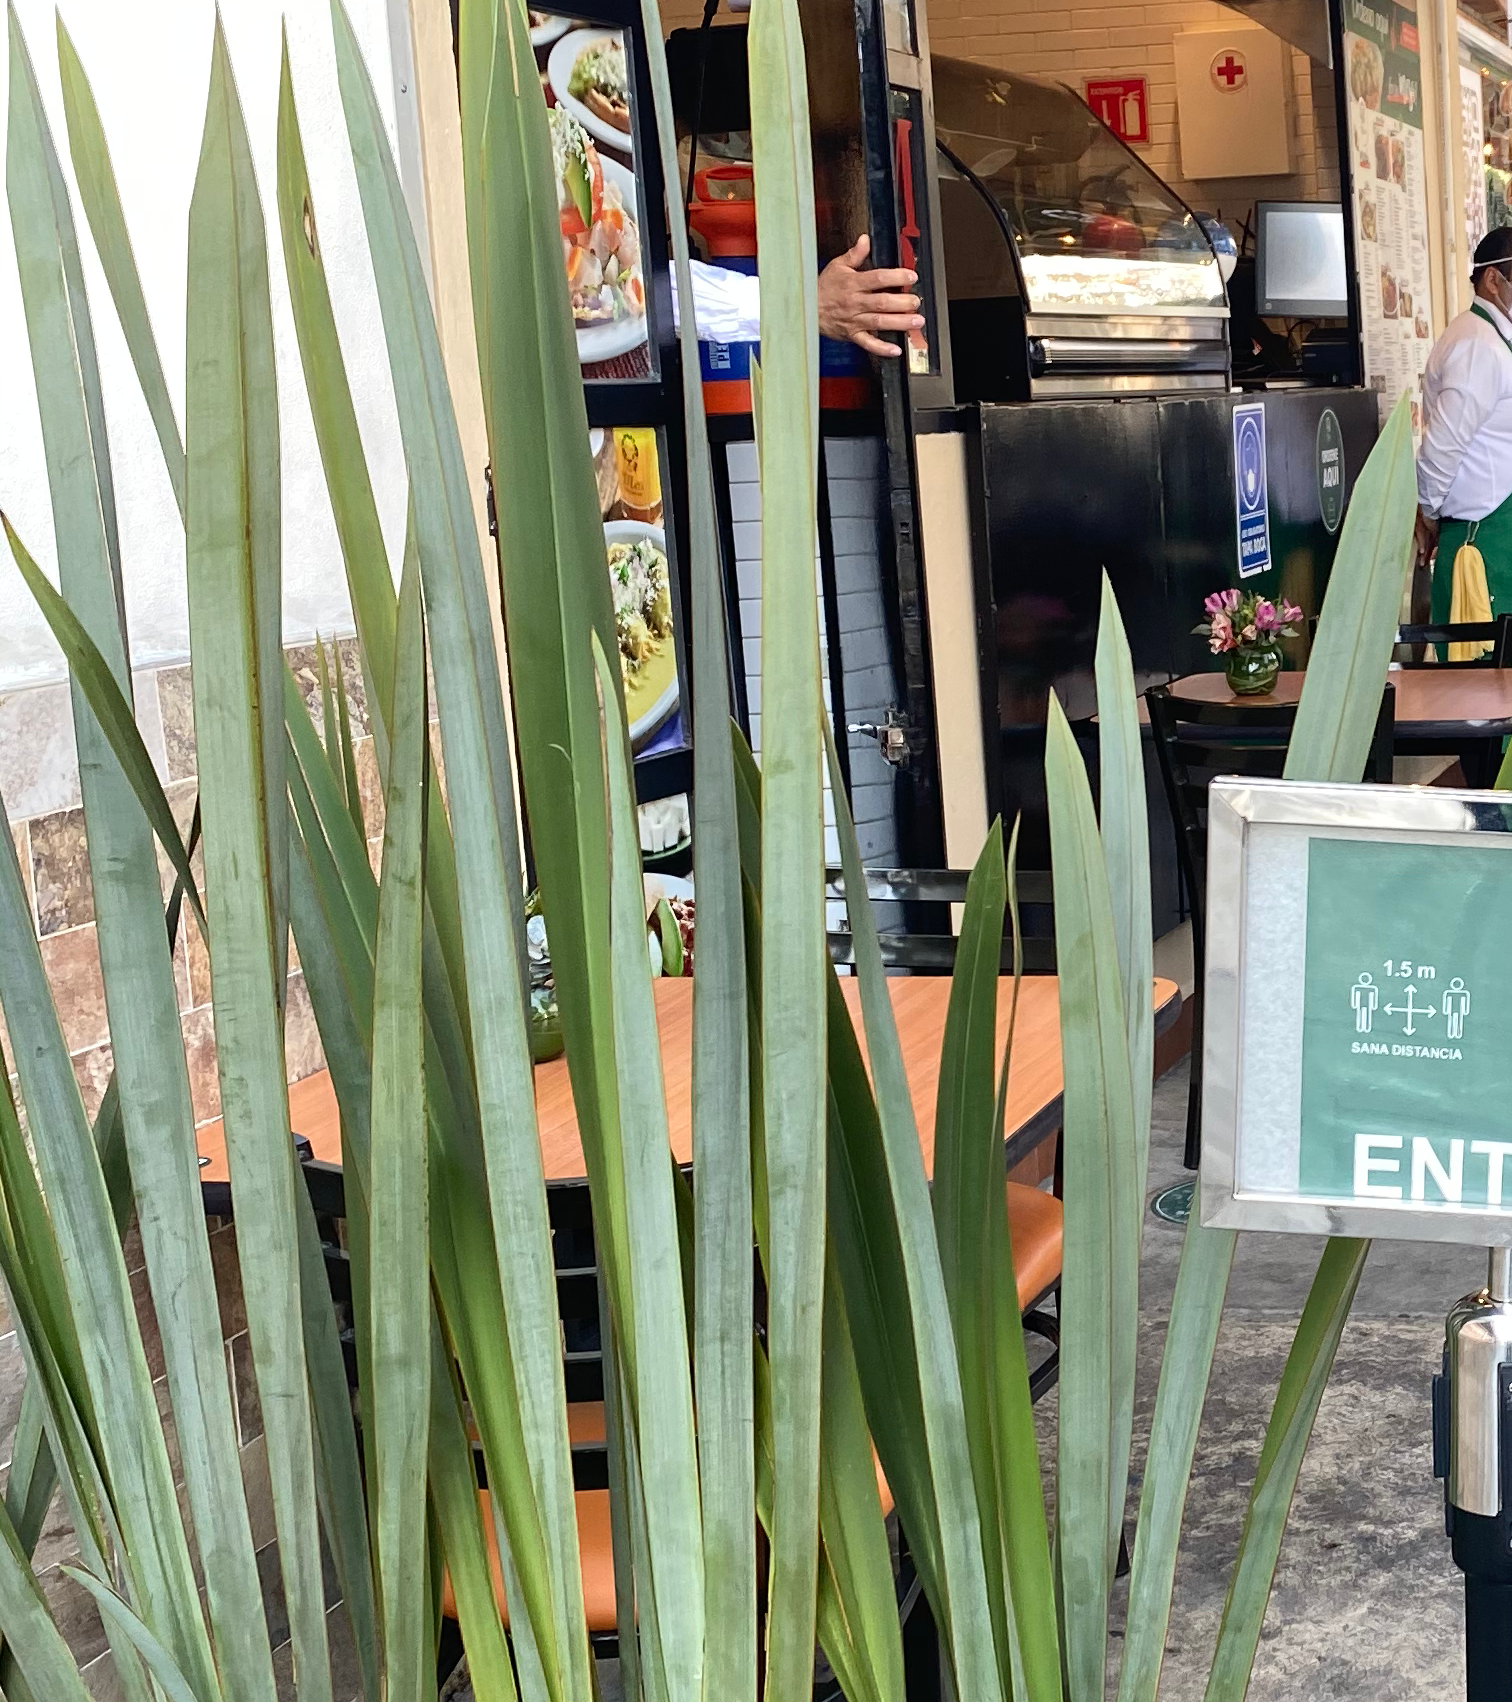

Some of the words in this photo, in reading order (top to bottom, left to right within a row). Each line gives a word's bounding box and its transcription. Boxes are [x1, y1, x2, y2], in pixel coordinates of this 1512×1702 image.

[1383, 959, 1413, 978] 1.5
[1417, 965, 1436, 979] m
[1351, 1041, 1389, 1055] SANA
[1391, 1044, 1463, 1060] DISTANCIA
